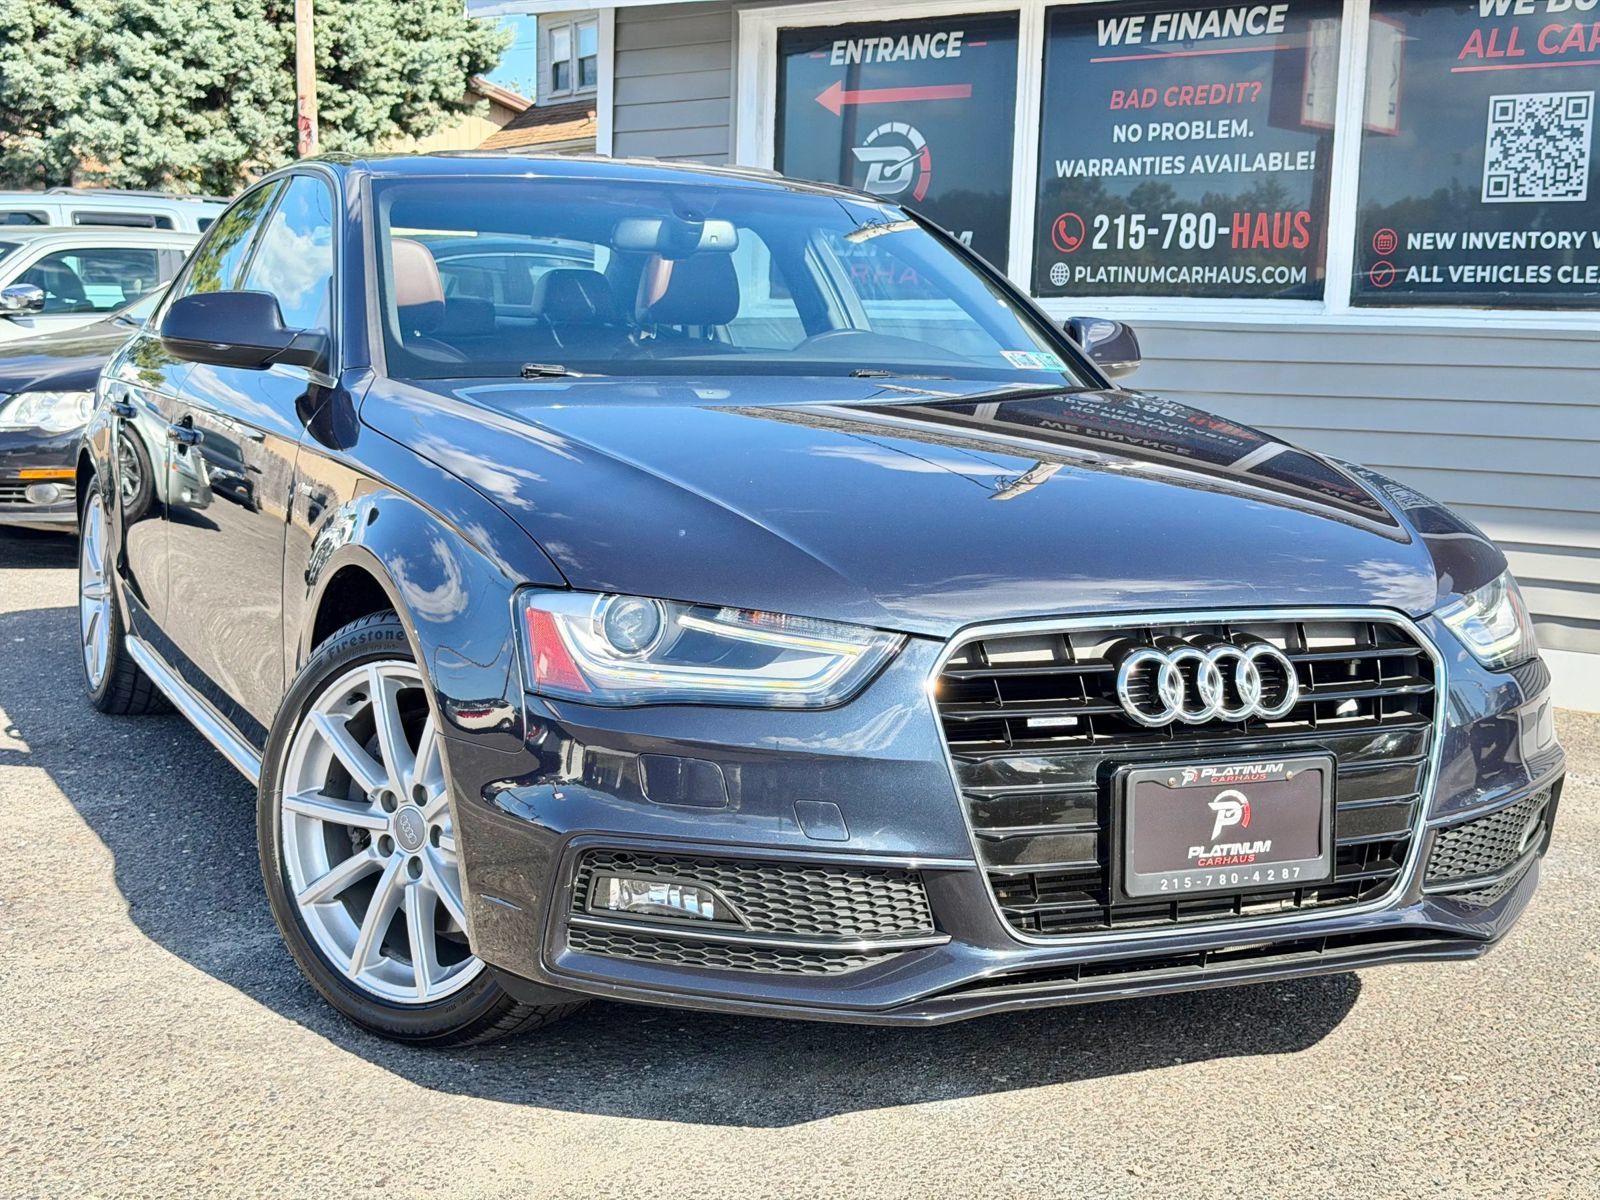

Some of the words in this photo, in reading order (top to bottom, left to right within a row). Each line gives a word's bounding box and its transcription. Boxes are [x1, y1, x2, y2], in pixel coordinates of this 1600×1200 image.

[1097, 16, 1145, 47] WE
[1150, 4, 1289, 43] FINANCE
[830, 31, 964, 66] ENTRANCE
[1457, 26, 1526, 60] ALL
[1110, 90, 1158, 110] BAD
[1163, 81, 1263, 107] CREDIT?
[1112, 124, 1143, 144] NO
[1147, 119, 1254, 142] PROBLEM.
[1055, 156, 1186, 178] WARRANTIES
[1190, 151, 1316, 174] AVAILABLE!
[1092, 211, 1311, 250] 215-780-HAUS
[1407, 231, 1458, 250] NEW
[1461, 231, 1587, 250] INVENTORY
[1074, 266, 1307, 284] PLATINUMCARHAUS.COM
[1404, 266, 1443, 283] ALL
[1448, 265, 1552, 284] VEHICLES
[1557, 265, 1600, 284] CLE
[1201, 763, 1284, 778] PLATINUM
[1210, 773, 1267, 784] CARHAUS
[1188, 840, 1272, 859] PLATINUM
[1198, 854, 1256, 867] CARHAUS
